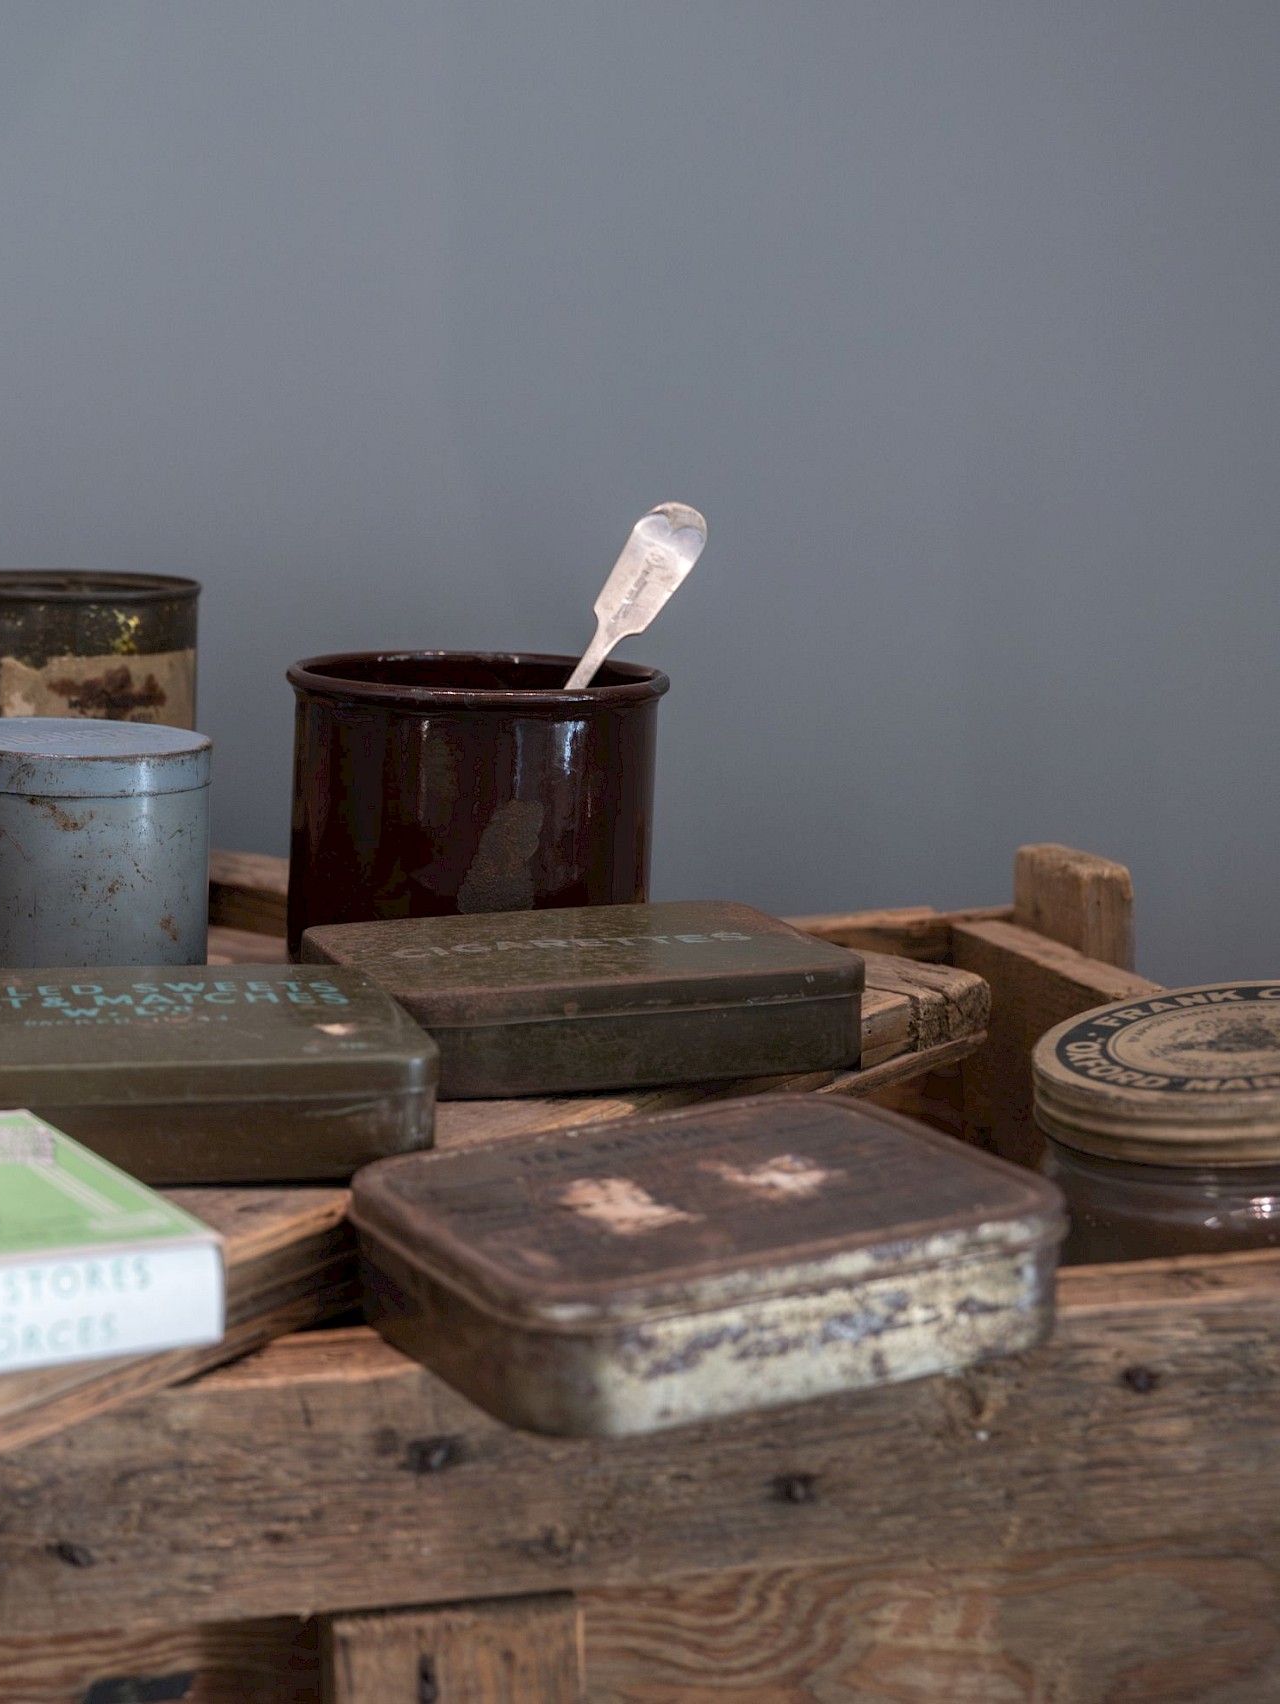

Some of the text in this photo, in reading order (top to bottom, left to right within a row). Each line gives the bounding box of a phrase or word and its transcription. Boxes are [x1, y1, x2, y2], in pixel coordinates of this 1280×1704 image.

[394, 932, 753, 959] CIGARETTES
[42, 997, 70, 1009] &
[94, 991, 349, 1006] MATCHES
[131, 981, 339, 993] SWEETS
[1092, 989, 1245, 1027] FRANK
[3, 1255, 152, 1306] STORES
